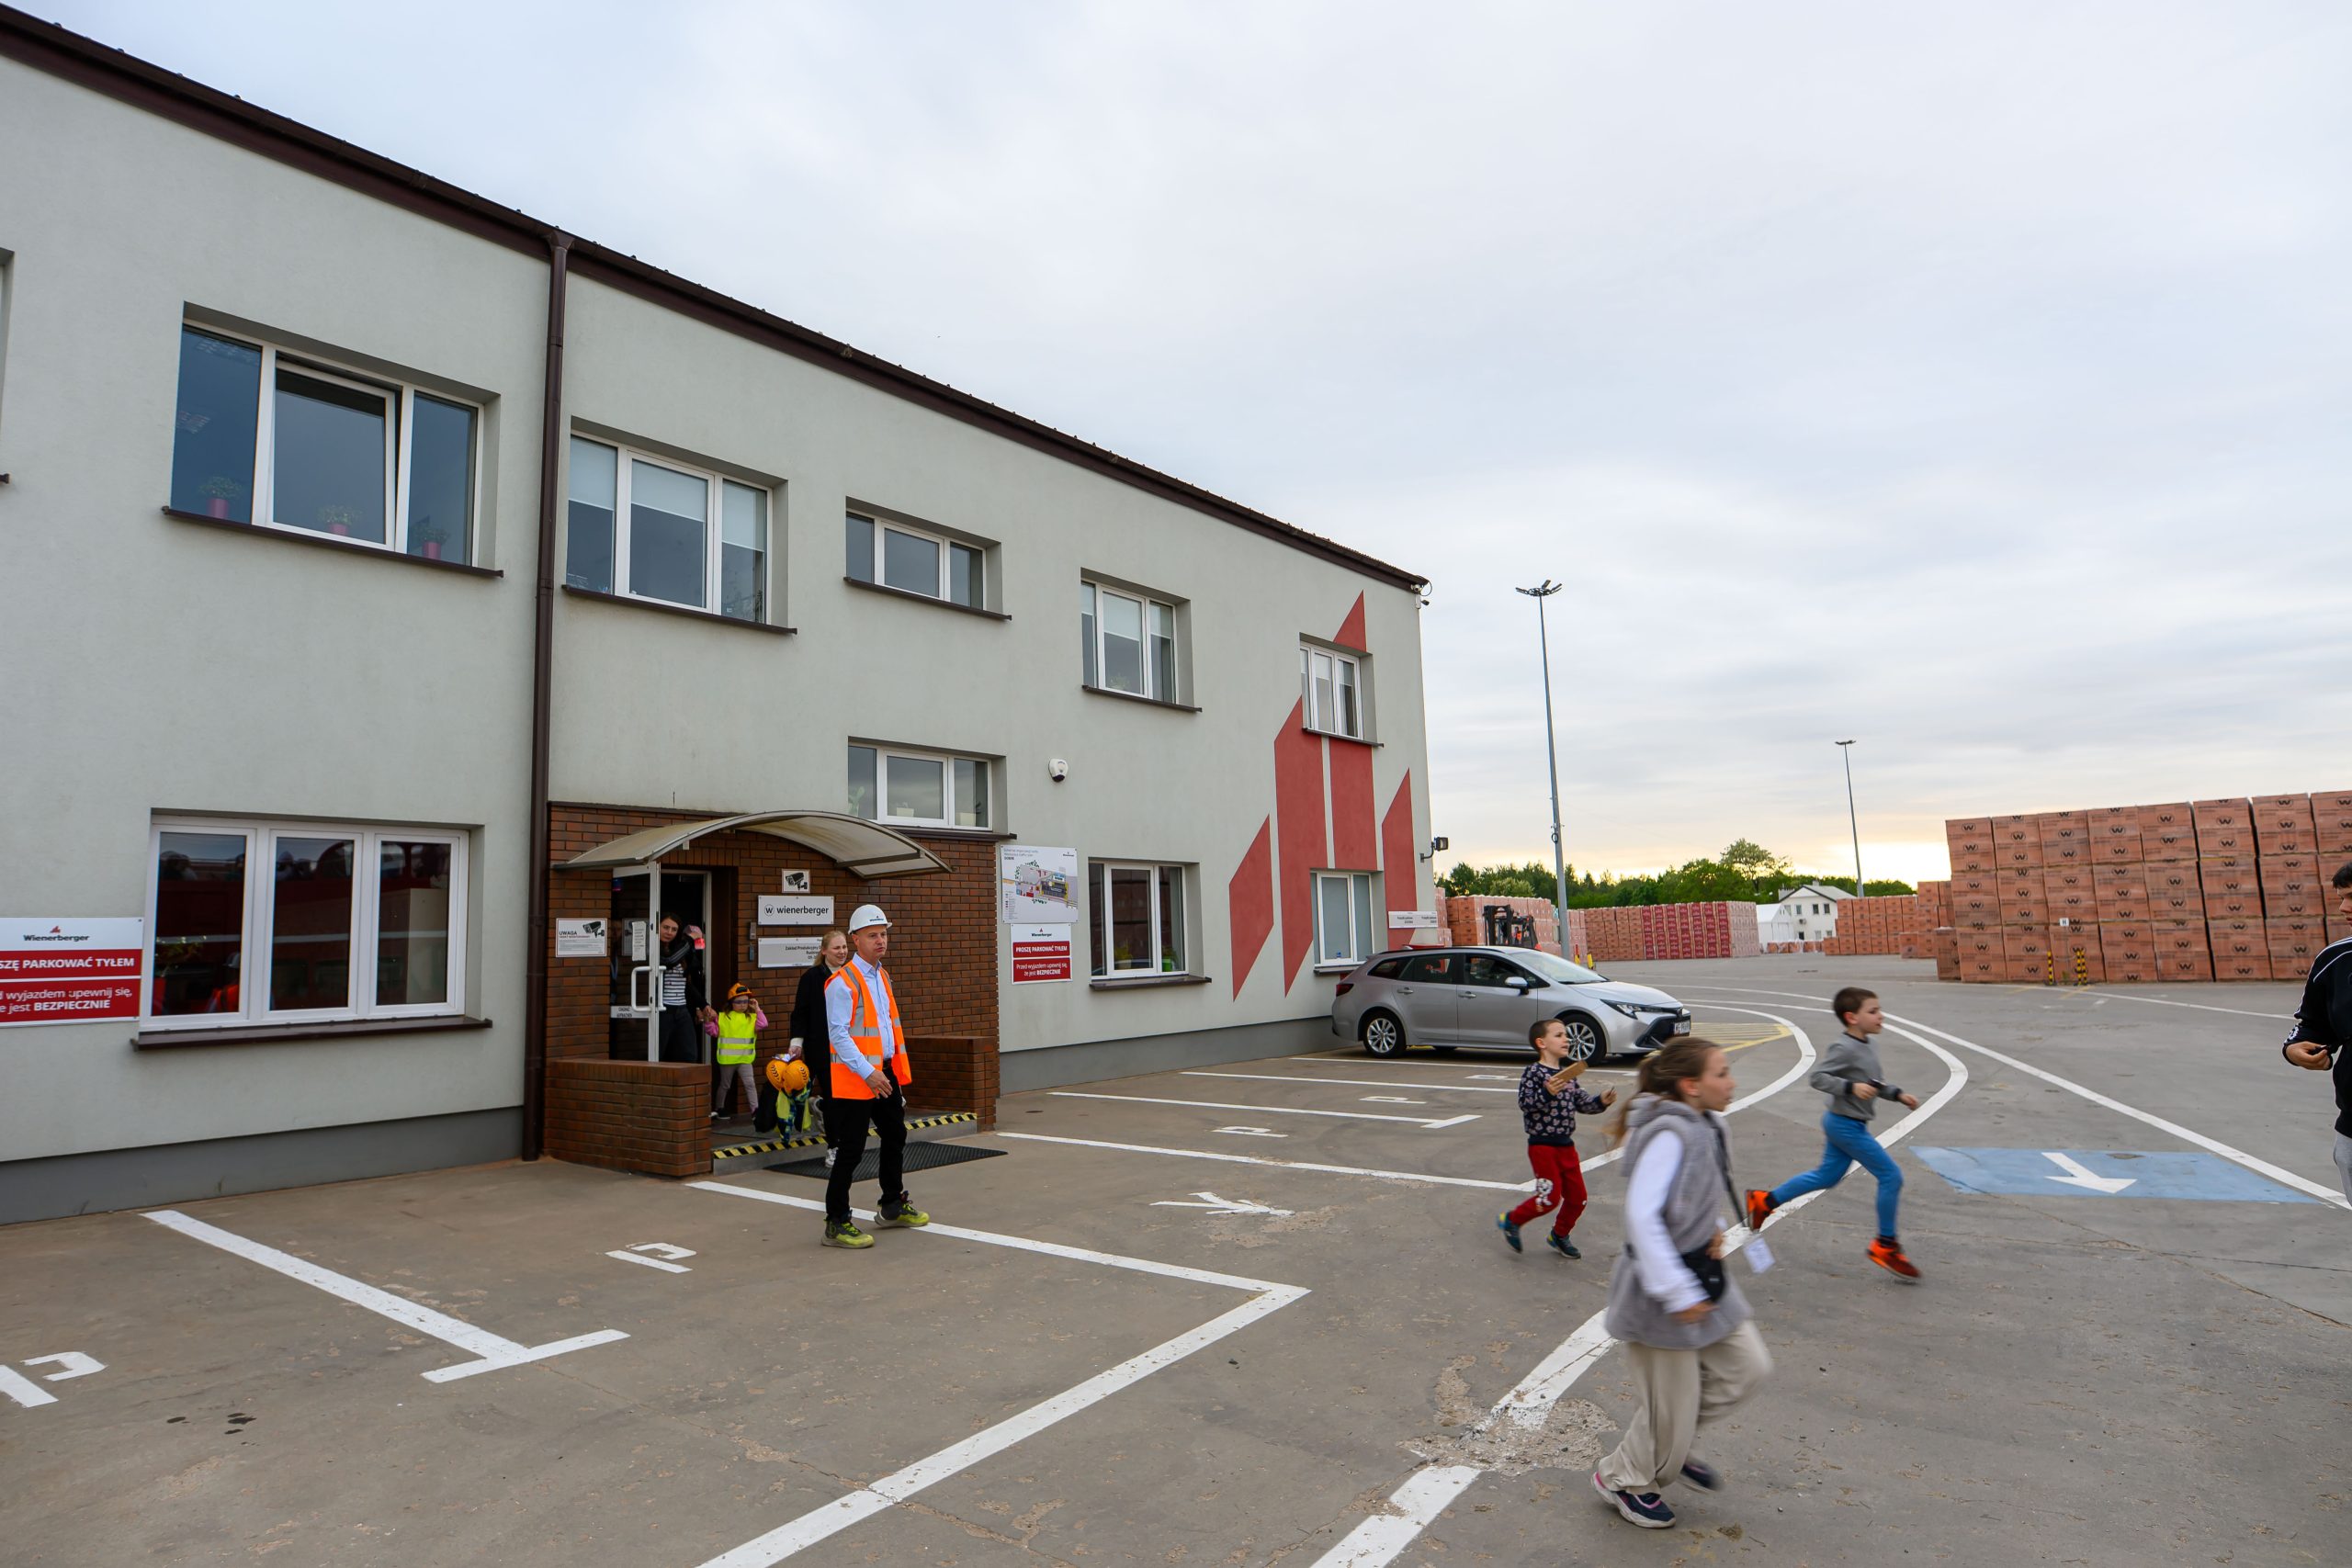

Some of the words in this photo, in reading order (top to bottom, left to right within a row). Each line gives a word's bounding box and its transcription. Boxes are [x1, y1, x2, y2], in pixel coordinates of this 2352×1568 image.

[777, 905, 829, 916] wienerberger
[22, 956, 94, 968] PARKOWAĆ
[96, 957, 134, 967] TYŁEM
[6, 989, 65, 1001] wyjazdem
[68, 987, 112, 999] upewnij
[115, 987, 132, 998] się,
[8, 1004, 30, 1014] jest
[34, 999, 110, 1011] BEZPIECZNIE
